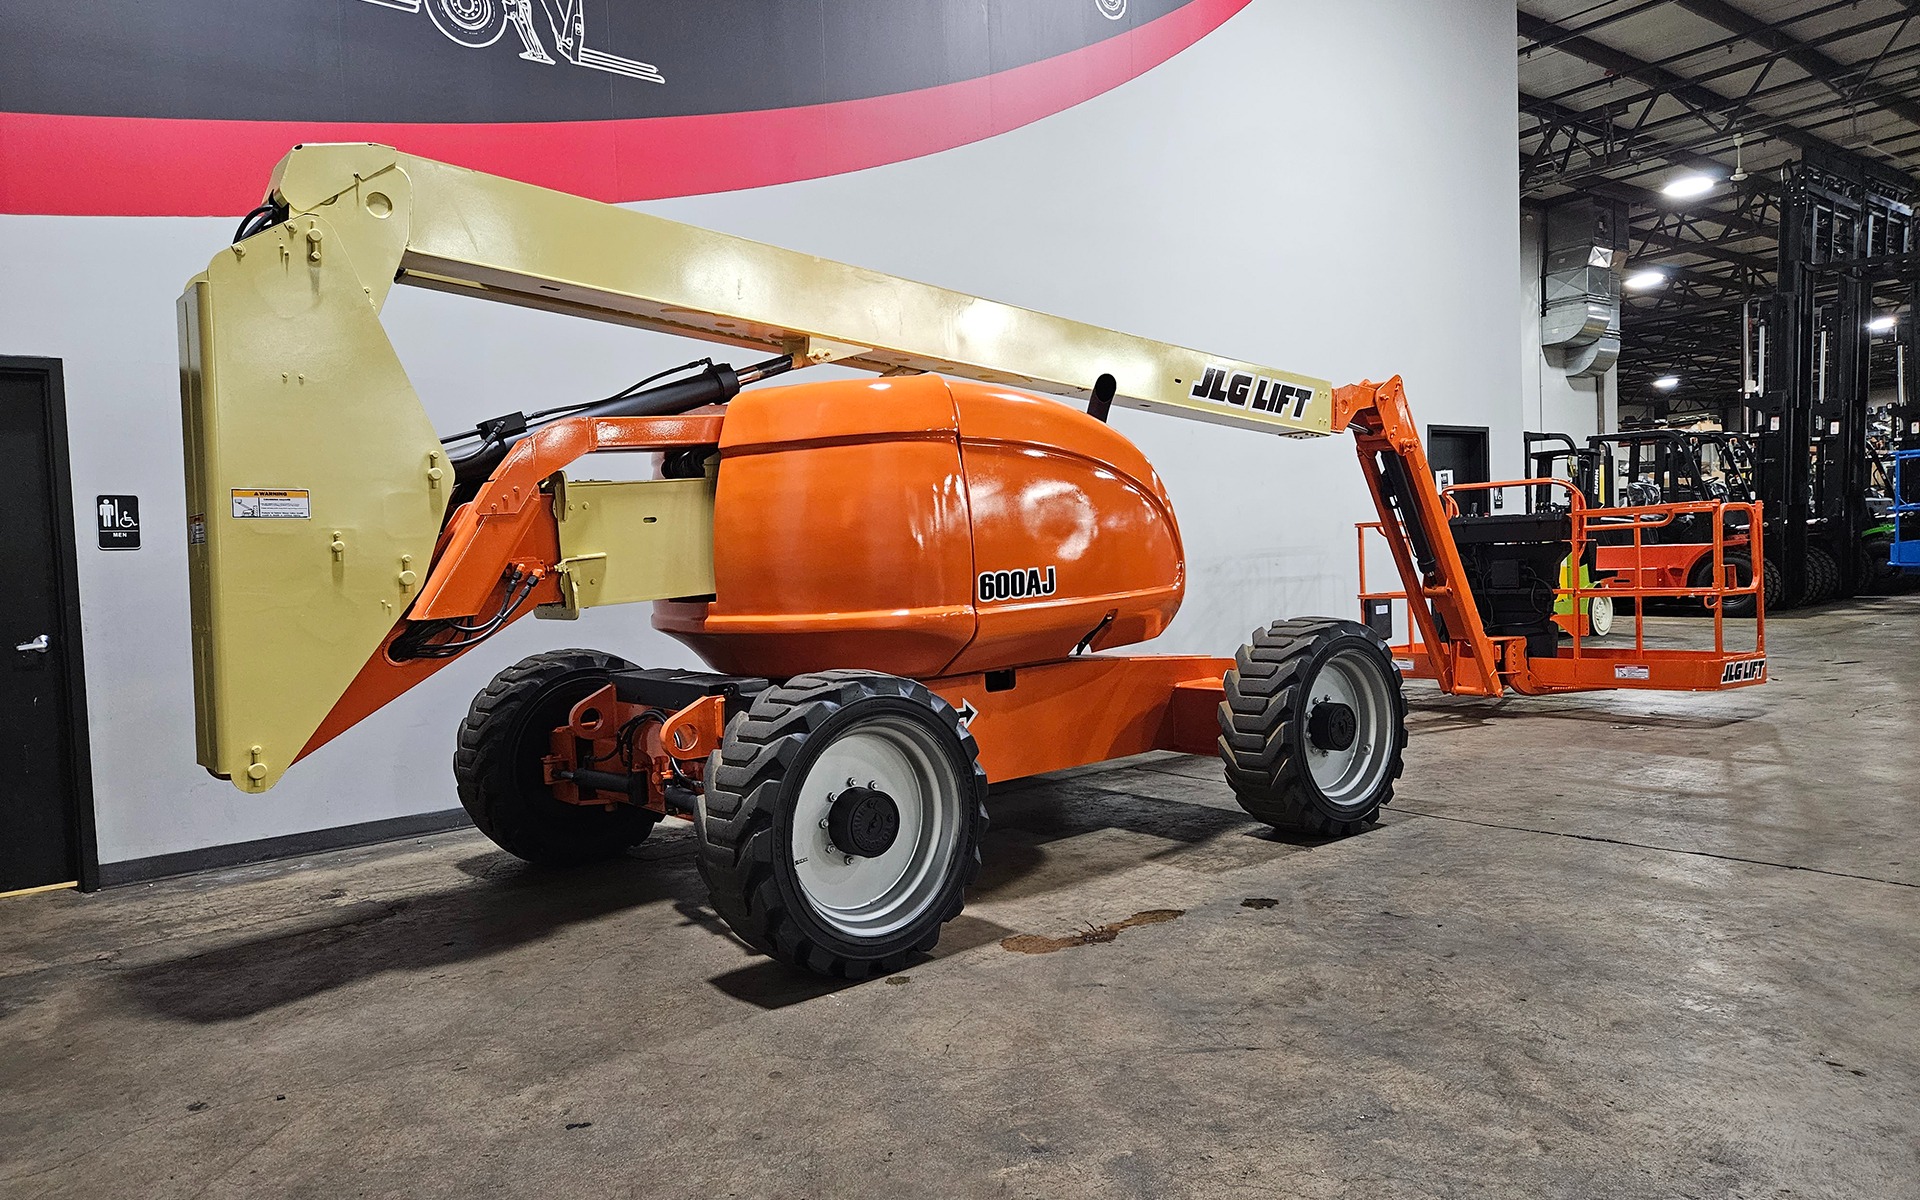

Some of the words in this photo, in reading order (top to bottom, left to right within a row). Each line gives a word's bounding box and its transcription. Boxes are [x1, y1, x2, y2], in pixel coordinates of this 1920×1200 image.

[1191, 366, 1253, 407] JLG
[1251, 379, 1313, 418] LIFT
[979, 567, 1055, 600] 600AJ
[1721, 662, 1744, 682] JLG
[1743, 660, 1765, 679] LIFT
